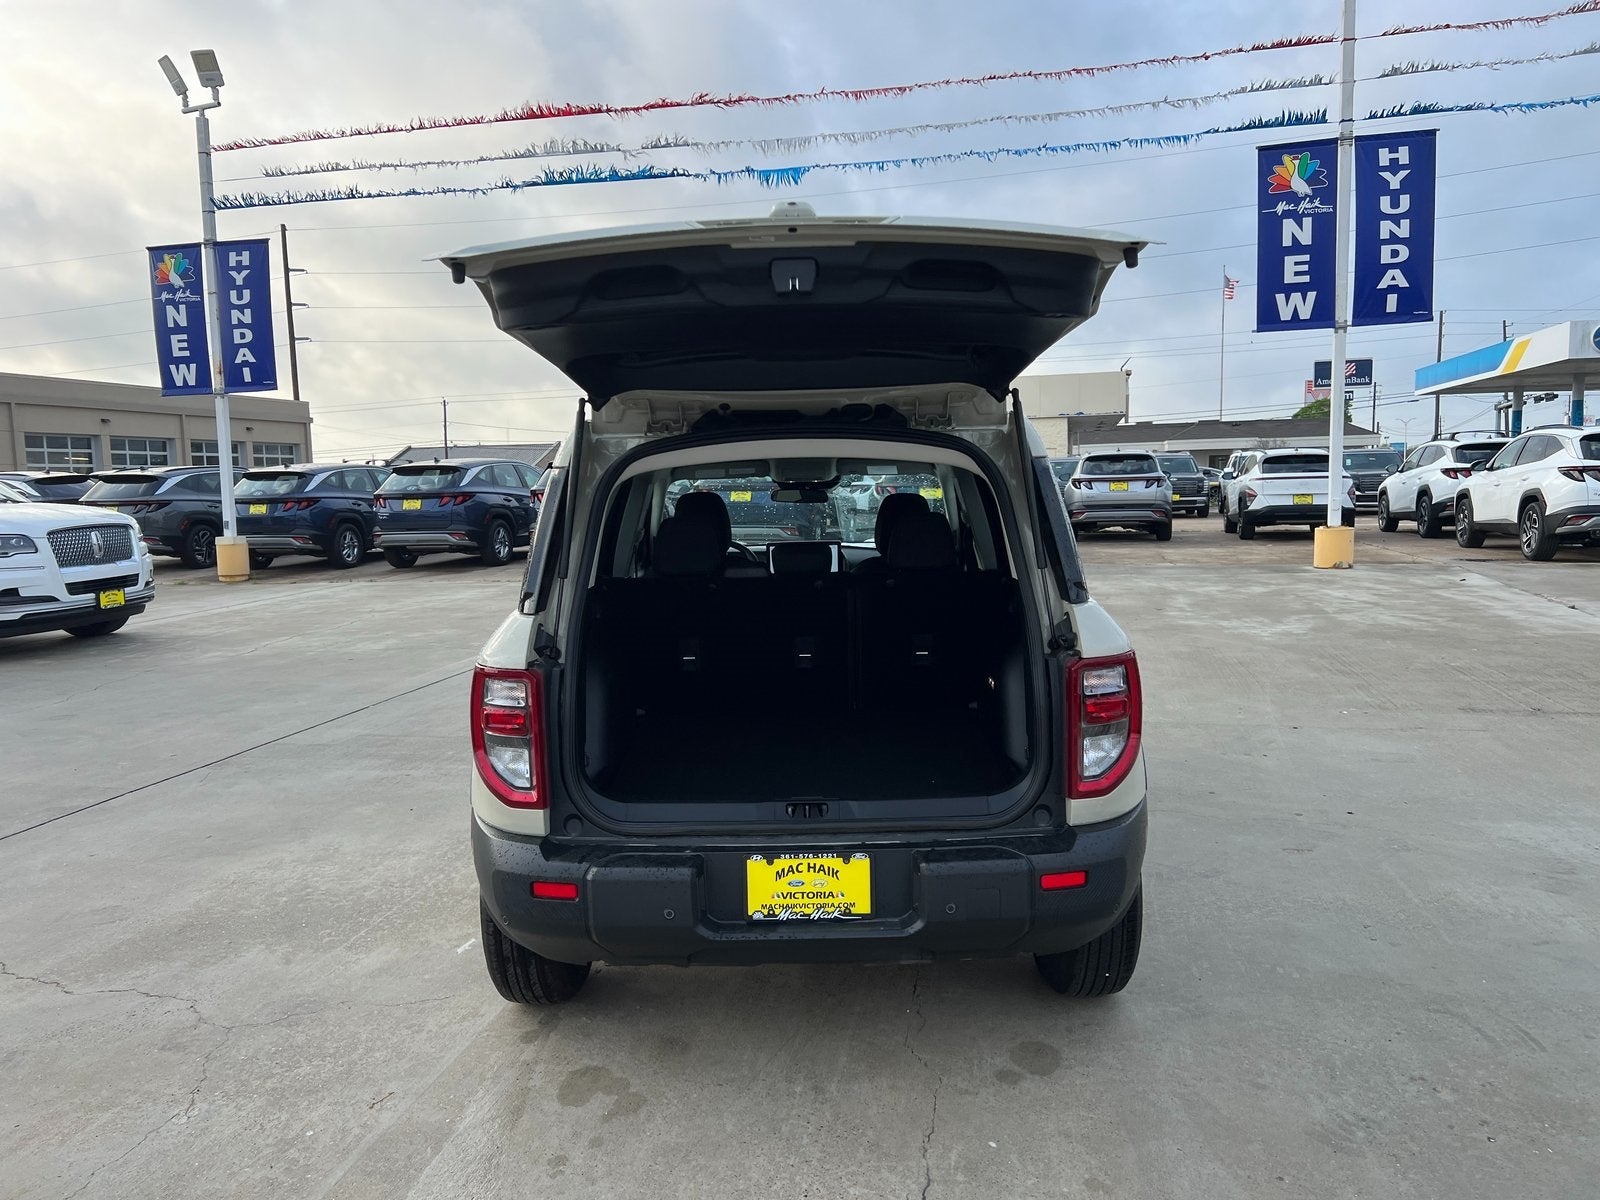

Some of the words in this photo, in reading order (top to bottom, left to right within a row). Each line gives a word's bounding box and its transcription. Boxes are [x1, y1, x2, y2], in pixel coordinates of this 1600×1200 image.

[1262, 201, 1297, 216] Mac
[1297, 197, 1333, 214] Haik
[1376, 146, 1411, 313] HYUNDAI
[1275, 217, 1317, 321] NEW
[228, 251, 256, 383] HYUNDAI
[165, 304, 197, 387] NEW
[775, 862, 803, 882] MAC
[807, 862, 840, 881] HAIK
[781, 891, 835, 900] VICTORIA
[761, 902, 856, 910] MACHAIKVICTORIA.COM
[768, 907, 809, 920] Mac
[809, 907, 858, 920] Haik
